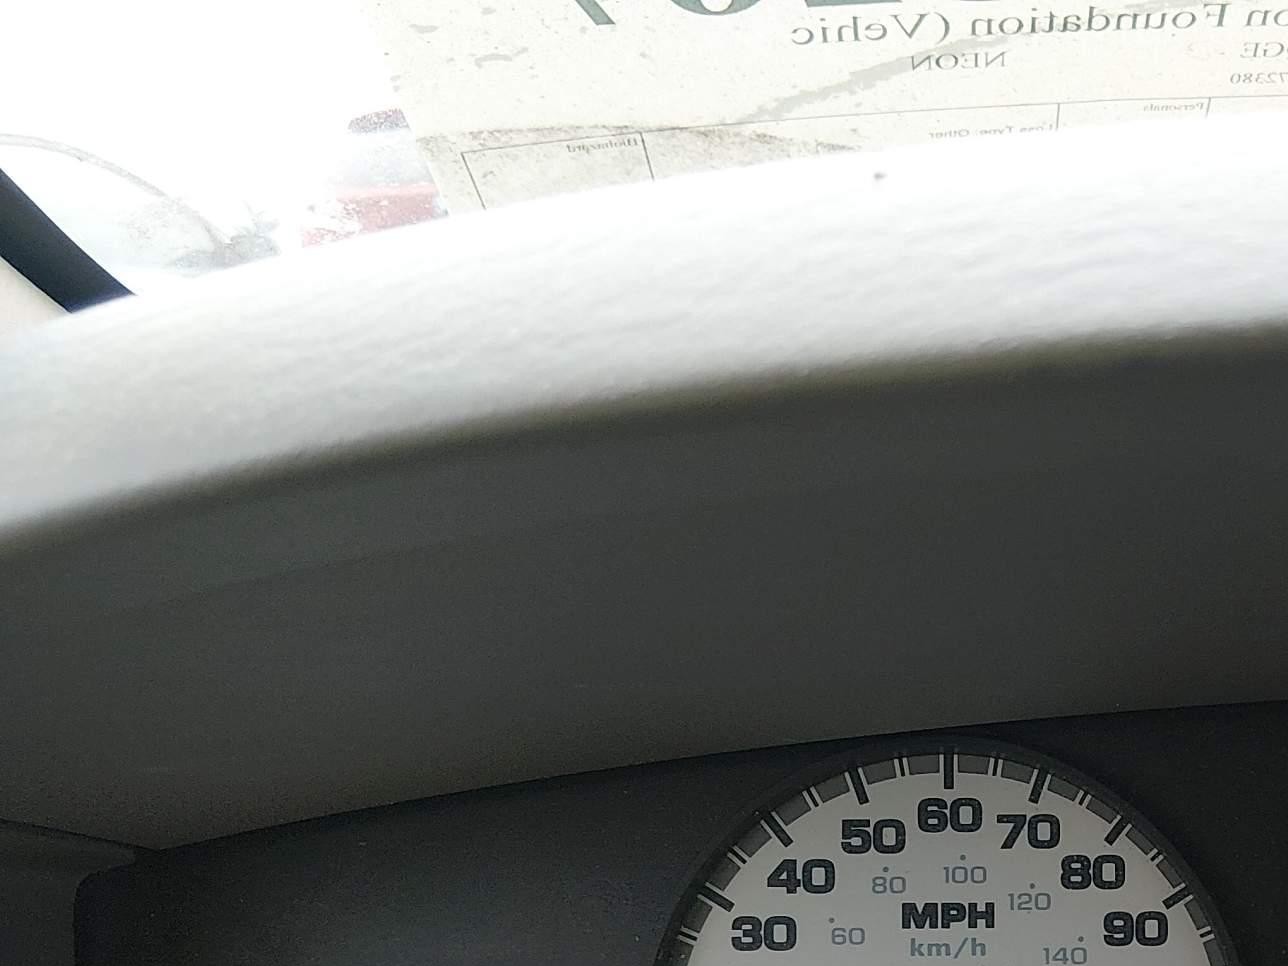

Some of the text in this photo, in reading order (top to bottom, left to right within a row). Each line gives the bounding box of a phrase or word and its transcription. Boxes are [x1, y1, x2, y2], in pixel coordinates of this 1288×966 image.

[917, 798, 983, 833] 60
[996, 813, 1061, 849] 70
[841, 818, 906, 854] 50
[767, 859, 836, 894] 40
[871, 875, 907, 895] 80
[943, 865, 988, 885] 100
[1060, 855, 1126, 890] 80
[901, 901, 996, 930] MPH
[1008, 892, 1052, 912] 120
[731, 916, 797, 951] 30
[831, 927, 866, 946] 60
[1102, 911, 1168, 947] 90
[909, 937, 988, 960] km/h
[1042, 946, 1088, 966] 140
